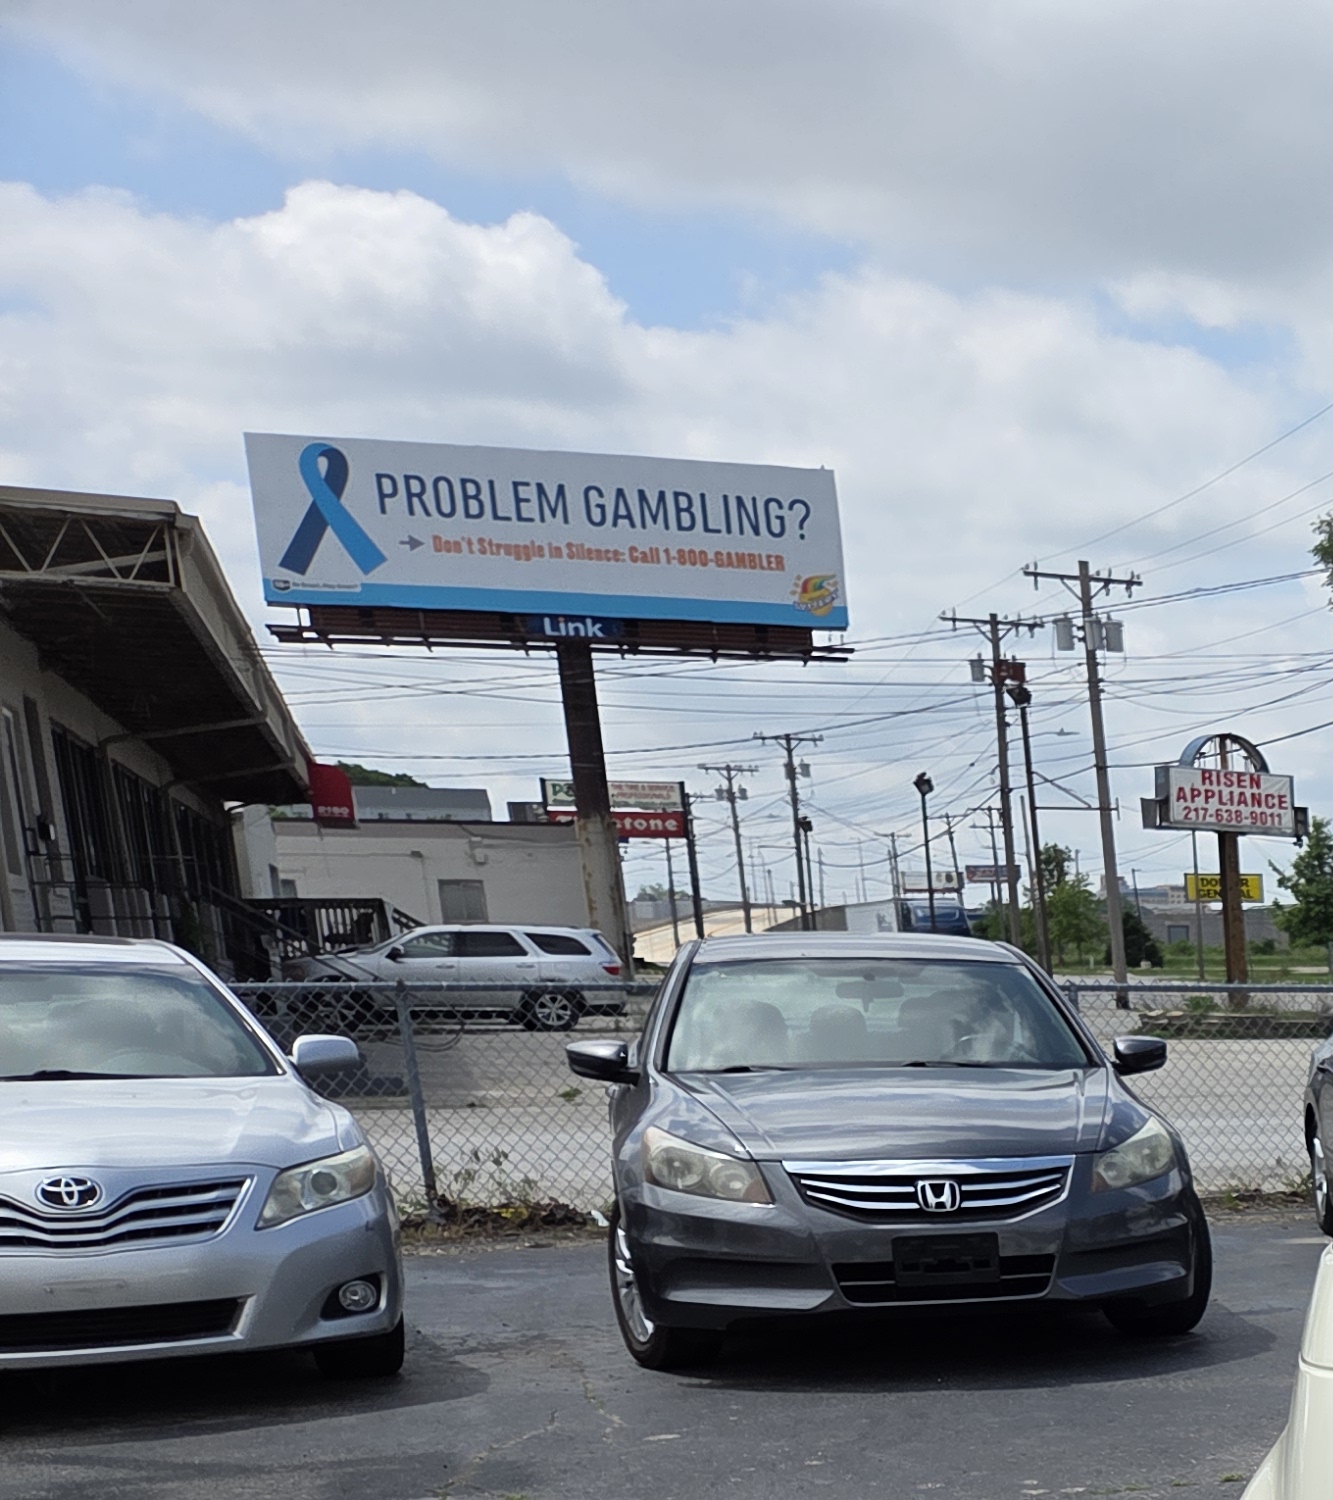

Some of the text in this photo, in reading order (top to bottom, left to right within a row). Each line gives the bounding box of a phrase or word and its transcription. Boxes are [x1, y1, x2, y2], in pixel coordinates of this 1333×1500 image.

[374, 472, 811, 540] PROBLEM GAMBLING?
[431, 534, 786, 572] Don't Struggle in Silence: Call 1-800-GAMBLER
[543, 616, 605, 638] Link
[1201, 770, 1262, 790] RISEN
[1176, 787, 1289, 811] APPLIANCE
[1183, 806, 1283, 827] 217-638-9011
[1200, 877, 1250, 888] DOR
[1198, 888, 1255, 899] GENAL
